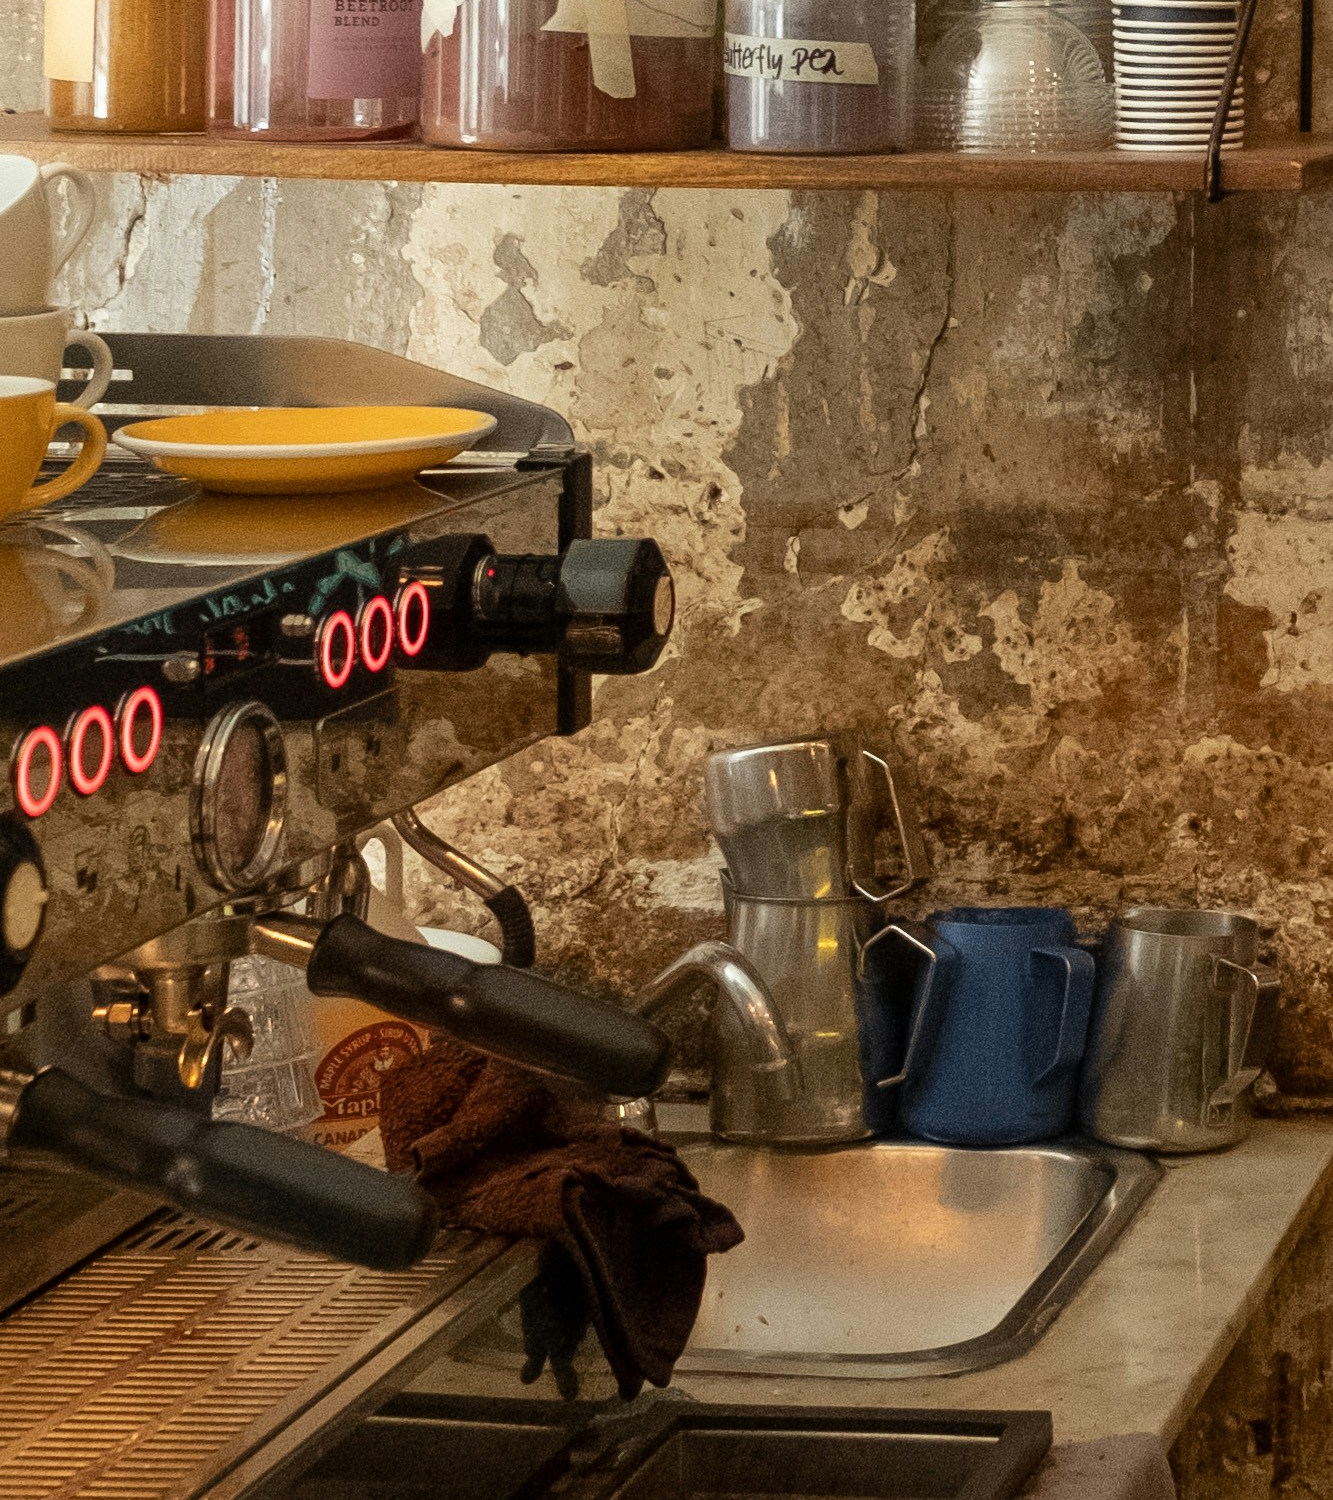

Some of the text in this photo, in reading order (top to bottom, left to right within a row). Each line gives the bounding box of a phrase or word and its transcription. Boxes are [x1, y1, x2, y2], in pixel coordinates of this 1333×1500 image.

[334, 17, 380, 26] BLEND
[320, 1056, 344, 1089] MAPLE
[341, 1033, 371, 1057] SYRUP
[322, 1092, 380, 1116] Mapl
